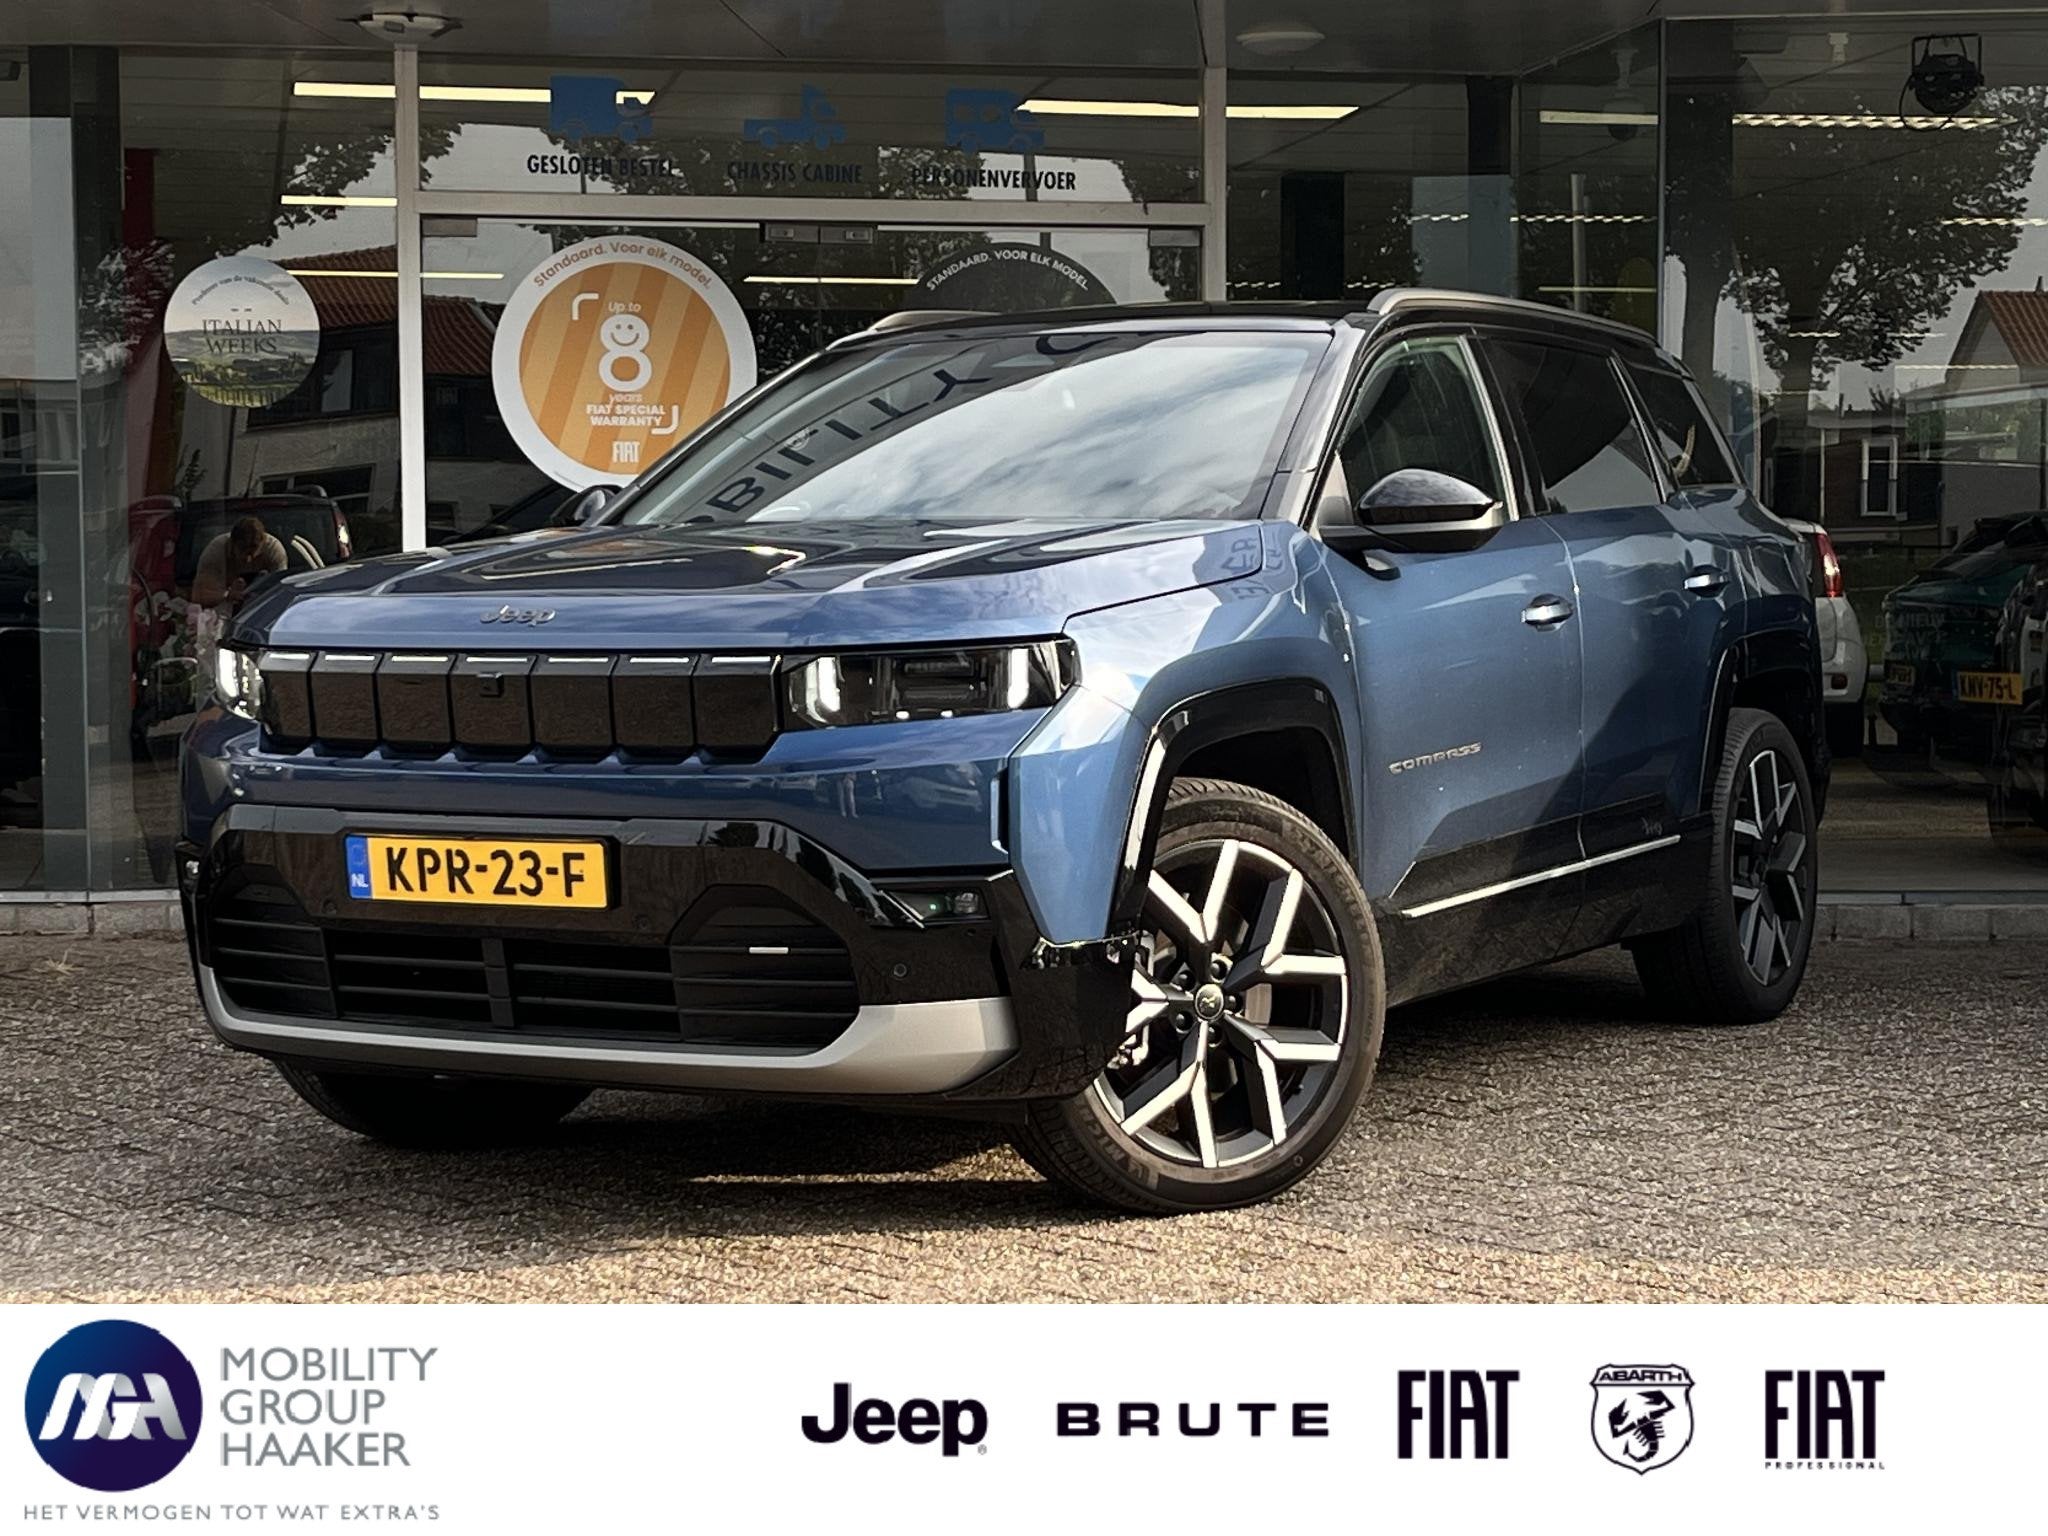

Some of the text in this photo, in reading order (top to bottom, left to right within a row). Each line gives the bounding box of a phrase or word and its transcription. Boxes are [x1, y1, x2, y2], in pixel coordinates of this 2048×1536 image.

[528, 155, 674, 178] GESLOTEN BESTEL
[727, 161, 863, 184] CHASSIS CABINE
[912, 168, 1077, 190] PERSONENVERVOER
[533, 243, 607, 287] Standaard.
[609, 241, 644, 255] Voor
[646, 244, 668, 261] elk
[994, 250, 1028, 261] VOOR
[1030, 251, 1052, 267] ELK
[608, 301, 642, 313] Up to
[202, 319, 282, 335] ITALIAN
[205, 337, 278, 354] WEEKS
[600, 314, 652, 392] 8
[586, 404, 666, 415] FIAT SPECIAL
[609, 394, 643, 409] years
[590, 415, 662, 427] WARRANTY
[612, 440, 640, 463] FIAT
[480, 604, 556, 628] Jeep
[351, 847, 586, 897] NL KPR-23-F
